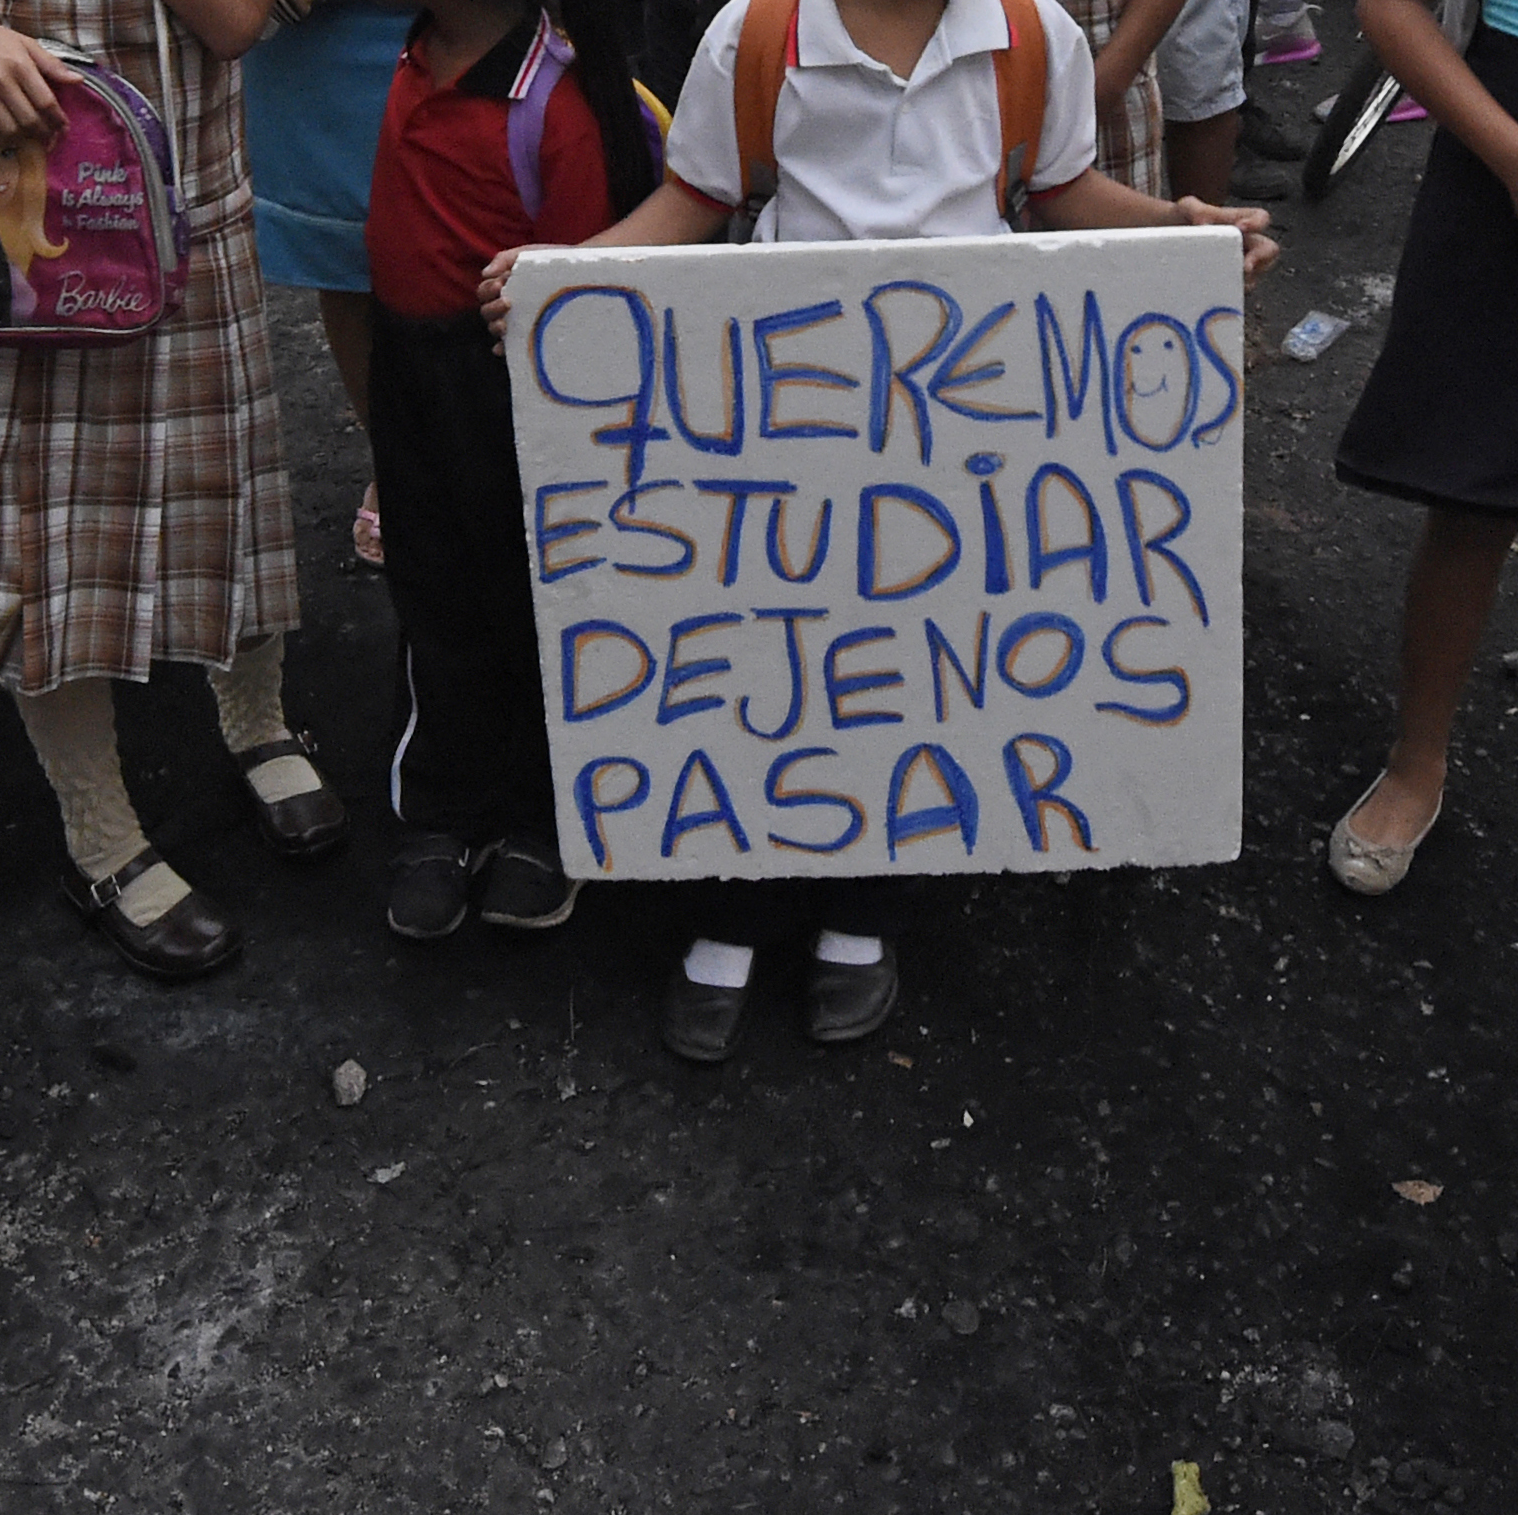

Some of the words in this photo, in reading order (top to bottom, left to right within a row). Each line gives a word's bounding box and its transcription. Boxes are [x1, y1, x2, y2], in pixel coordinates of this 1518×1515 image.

[76, 184, 144, 213] Always
[77, 159, 128, 184] Pink
[55, 270, 152, 317] Barbie
[530, 280, 1243, 495] QUEREMOS
[535, 452, 1210, 626] ESTUDIAR
[560, 607, 1191, 740] DEJENOS
[573, 732, 1099, 871] PASAR
